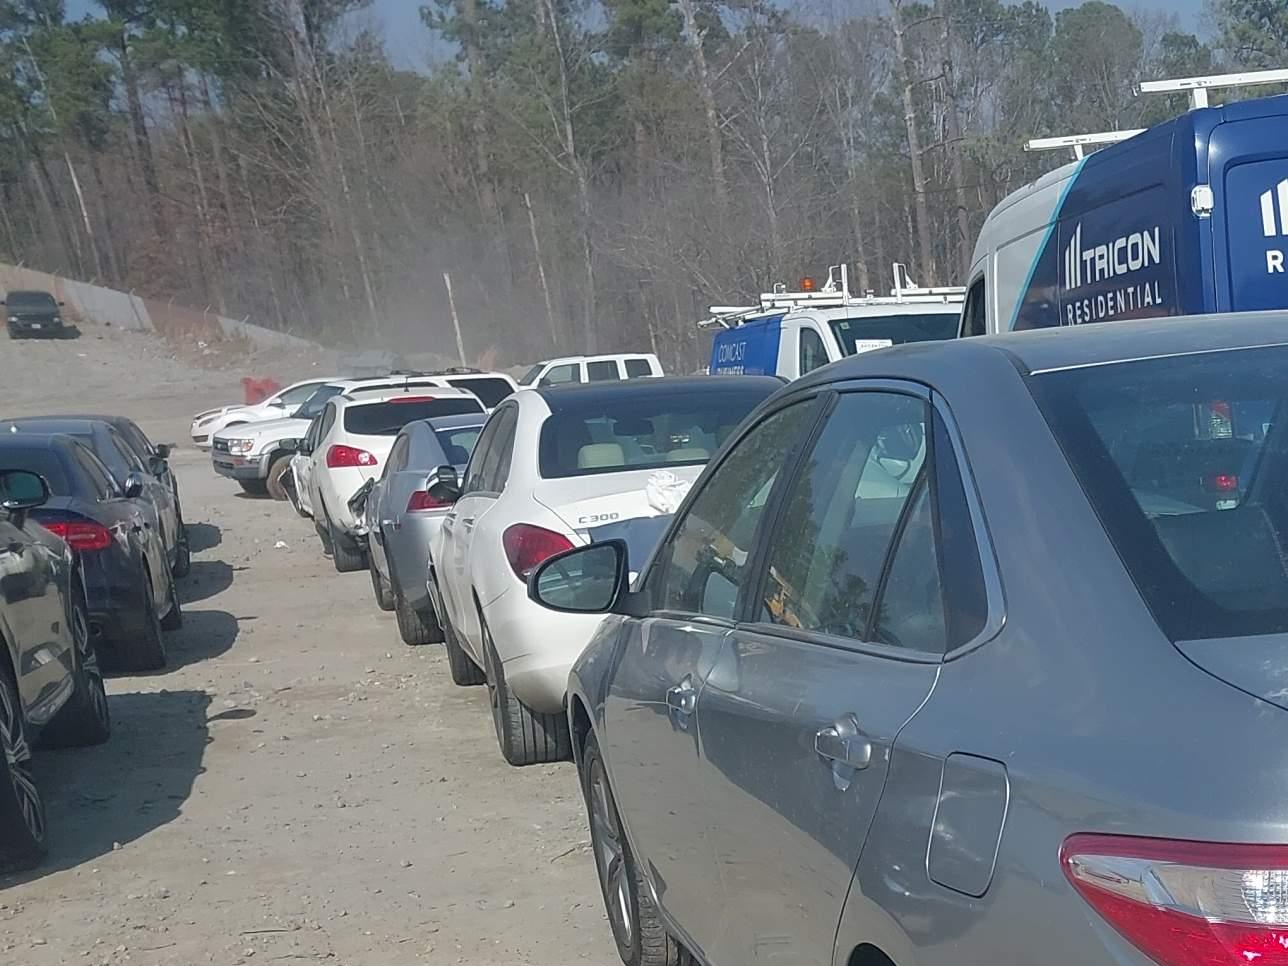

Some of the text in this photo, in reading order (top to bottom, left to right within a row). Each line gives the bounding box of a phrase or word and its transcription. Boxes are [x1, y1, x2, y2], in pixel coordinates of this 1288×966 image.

[1082, 226, 1160, 284] TRICON
[1067, 280, 1162, 327] RESIDENTIAL
[718, 341, 747, 363] COMCAST
